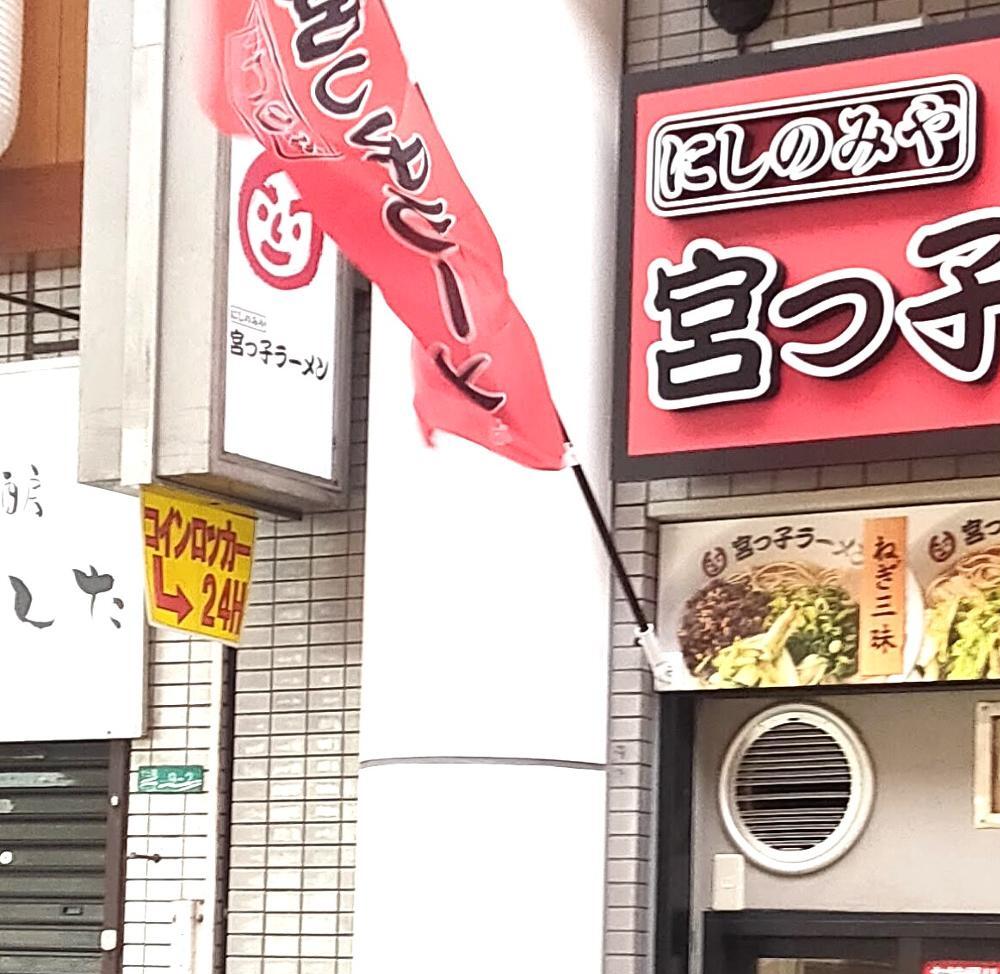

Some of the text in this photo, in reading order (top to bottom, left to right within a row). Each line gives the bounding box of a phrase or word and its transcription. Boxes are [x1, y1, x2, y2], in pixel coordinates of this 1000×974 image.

[660, 93, 962, 200] にしのみや
[230, 328, 329, 381] 宮っ子ラーメン
[144, 506, 251, 572] コインロッカー
[200, 572, 249, 636] 24H
